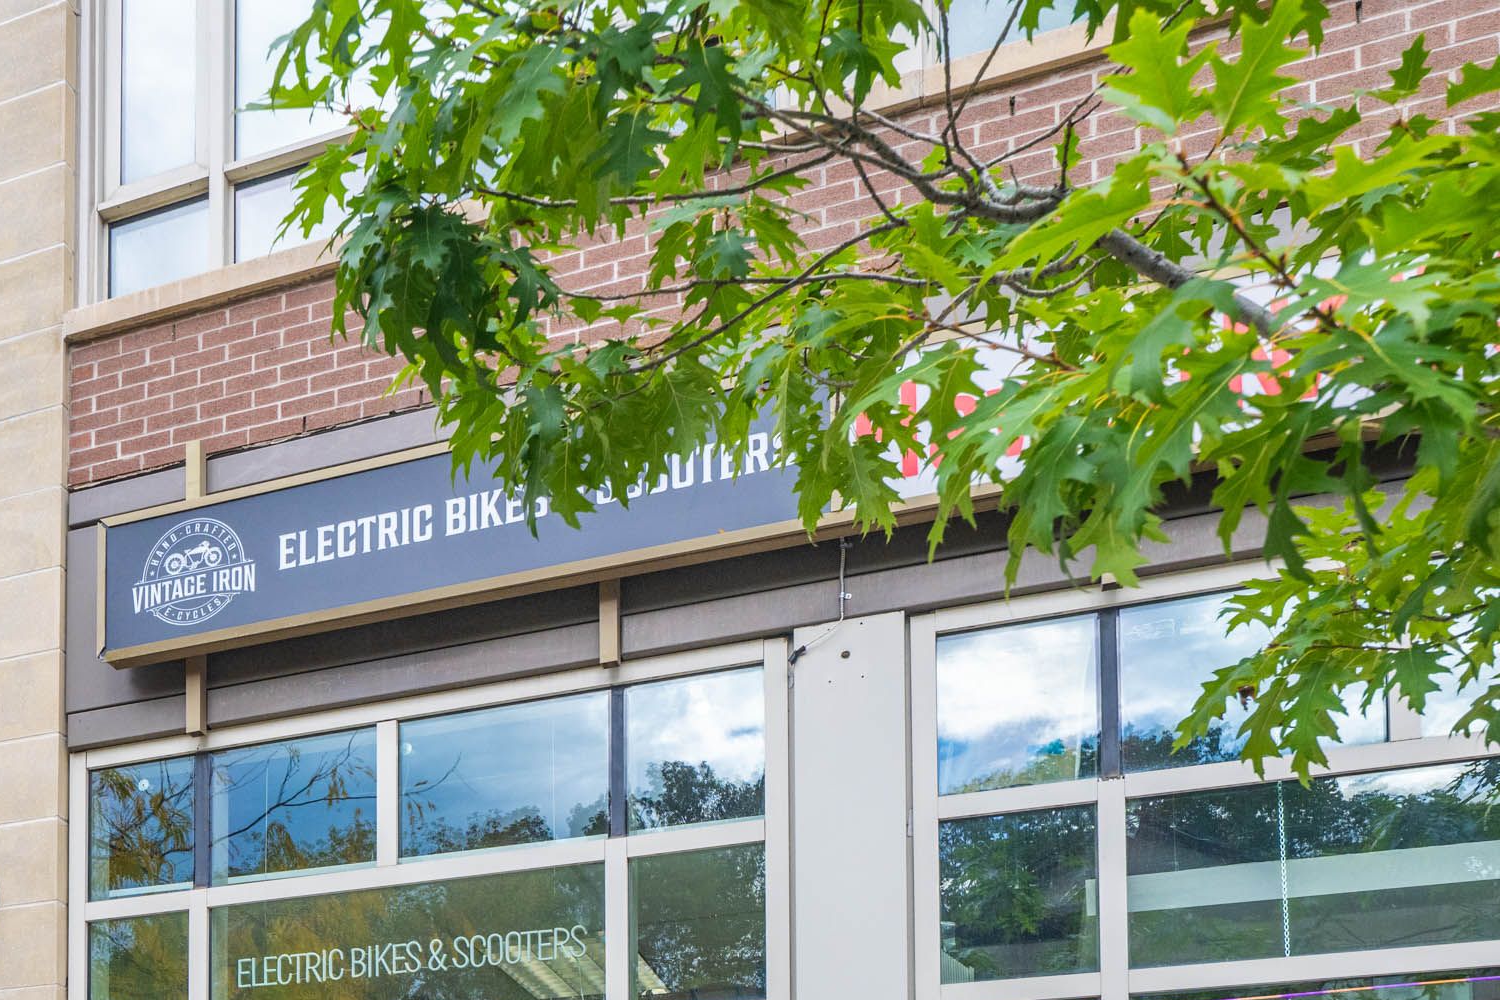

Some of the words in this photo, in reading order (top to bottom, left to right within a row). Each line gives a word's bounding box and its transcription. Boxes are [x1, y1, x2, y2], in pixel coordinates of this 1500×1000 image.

[278, 504, 433, 571] ELECTRIC
[597, 432, 797, 504] OTERS
[151, 523, 237, 566] HAND-CRAFTED
[132, 574, 207, 614] VINTAGE
[213, 563, 256, 592] IRON
[164, 597, 221, 621] E-CYCLES
[237, 948, 344, 988] ELECTRIC
[351, 941, 421, 978] BIKES
[428, 939, 448, 971] &
[452, 924, 588, 970] SCOOTERS
